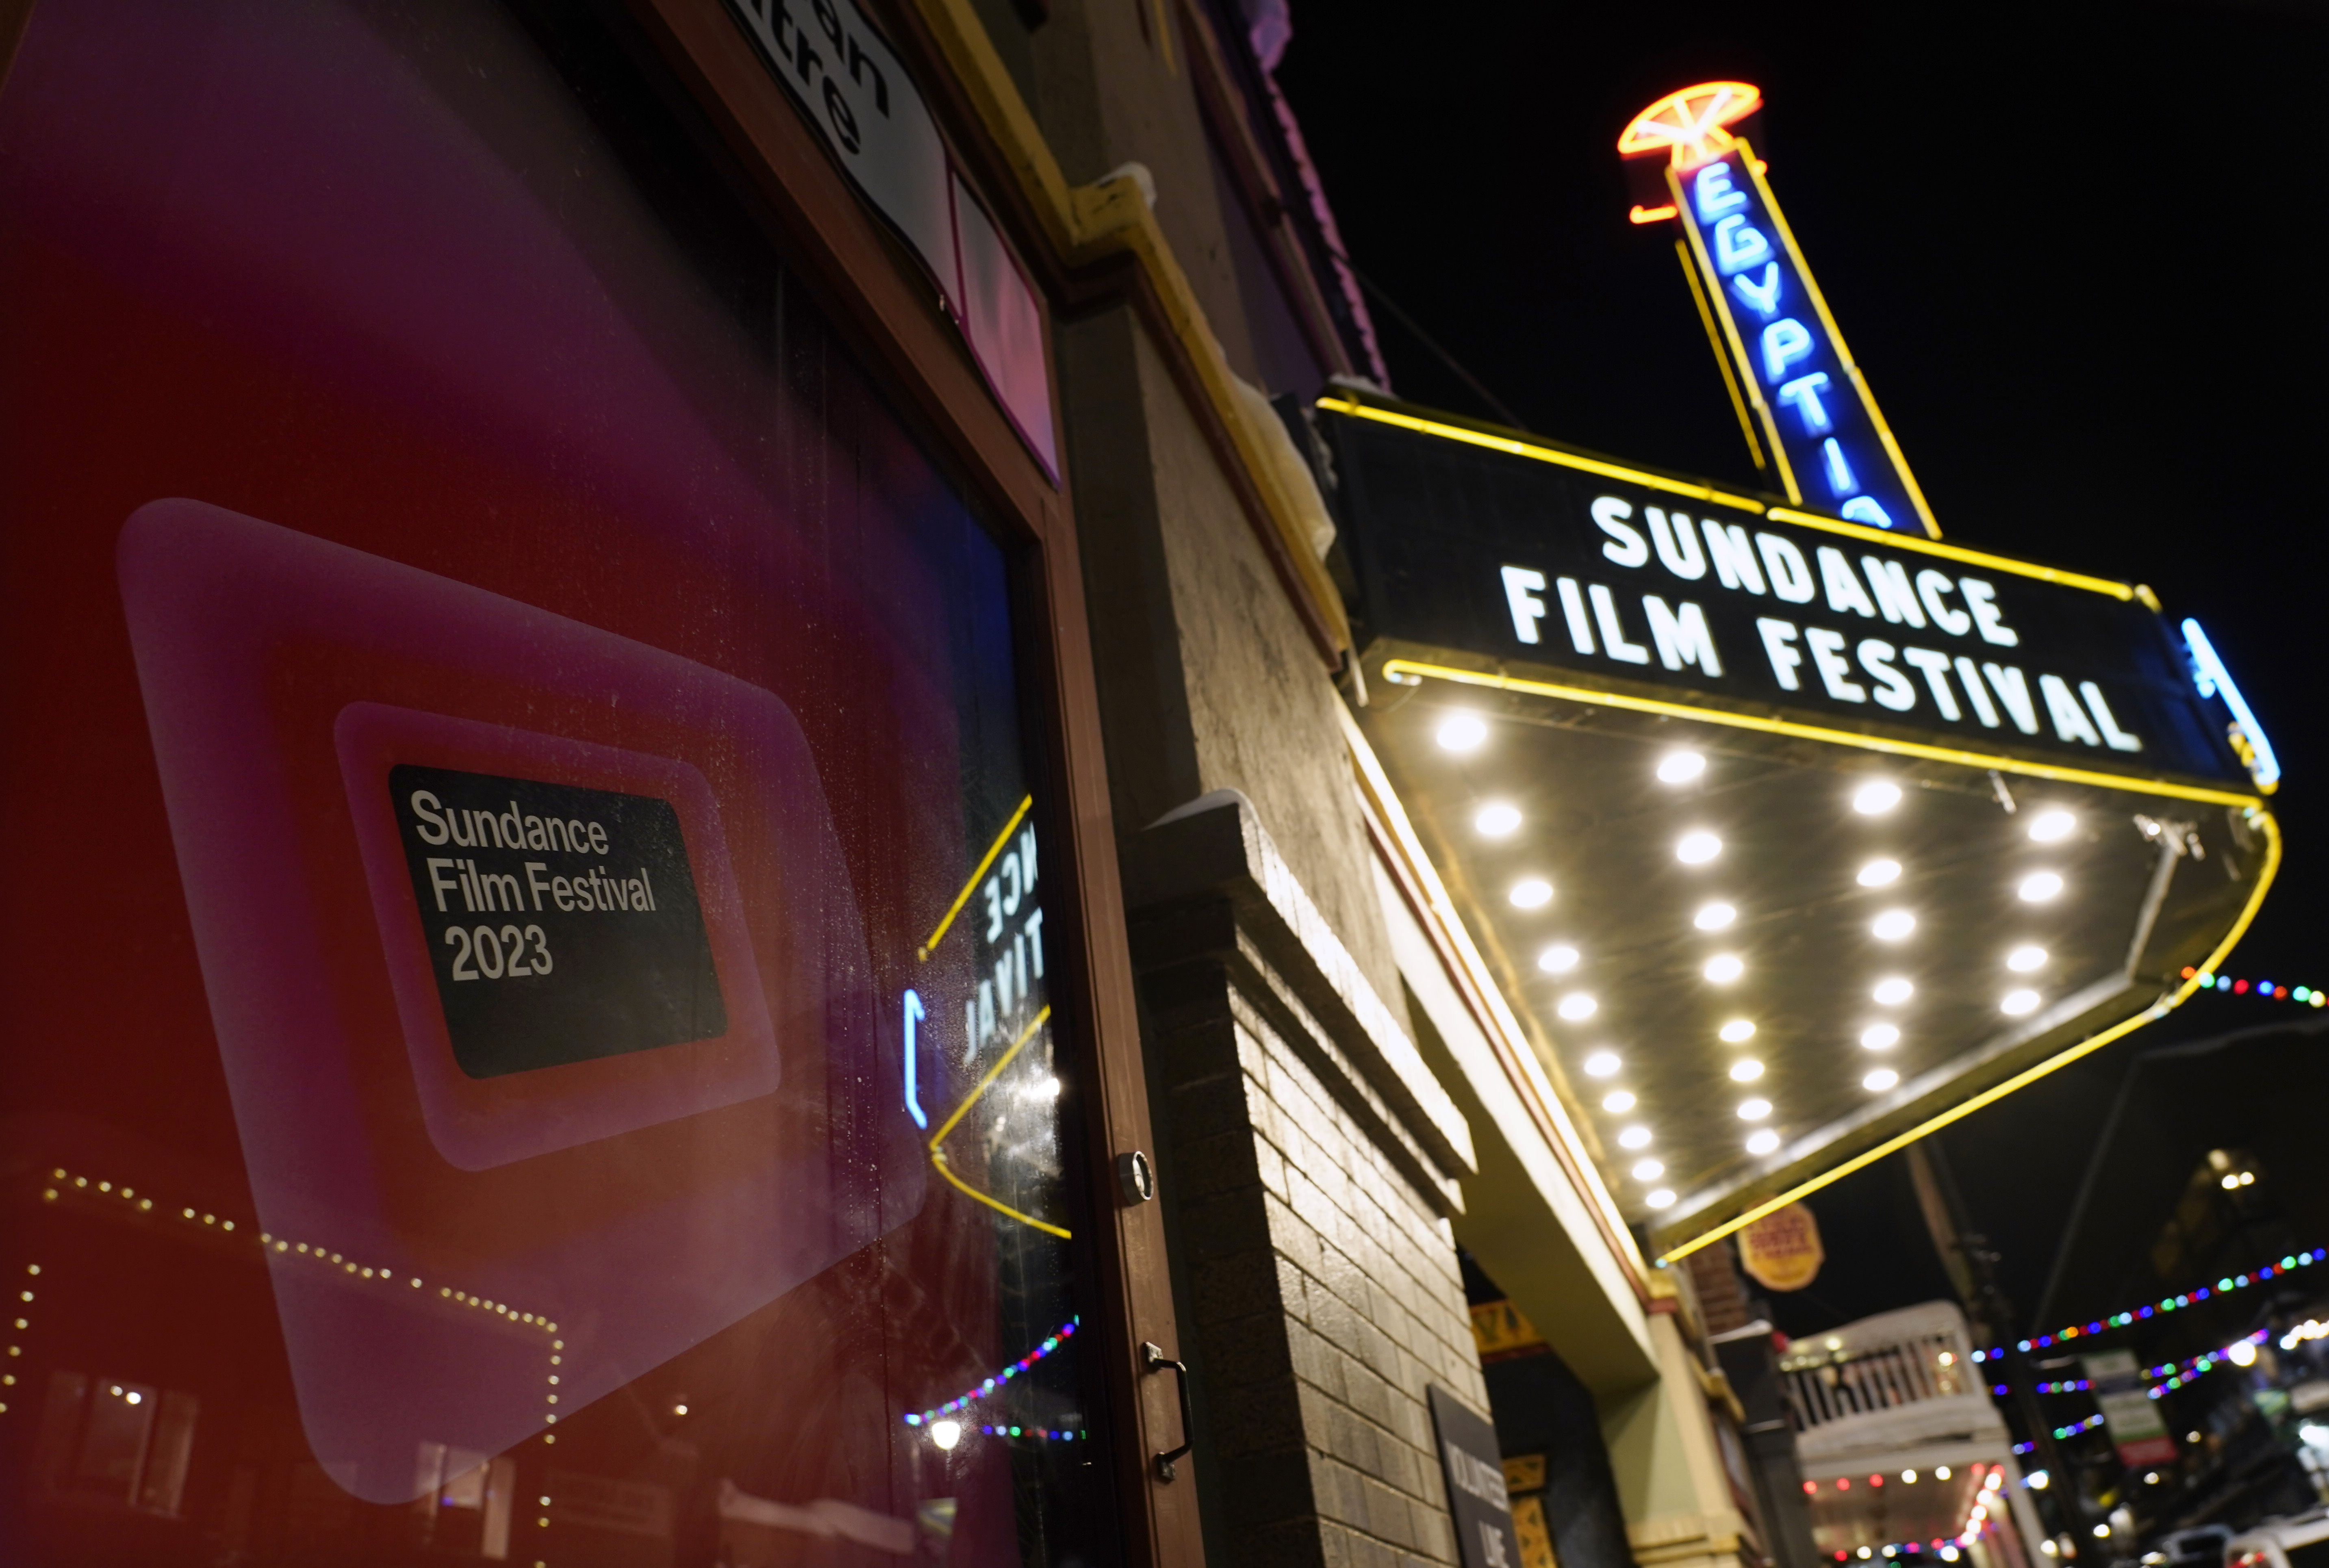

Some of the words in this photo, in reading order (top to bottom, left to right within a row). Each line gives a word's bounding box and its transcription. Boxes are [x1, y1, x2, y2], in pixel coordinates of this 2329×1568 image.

[751, 0, 861, 155] tre
[1590, 495, 2019, 647] SUNDANCE
[1500, 565, 1724, 678] FILM
[1756, 616, 2143, 753] FESTIVAL
[411, 790, 610, 856] Sundance
[426, 857, 525, 912] Film
[525, 861, 657, 912] Festival
[445, 924, 553, 981] 2023
